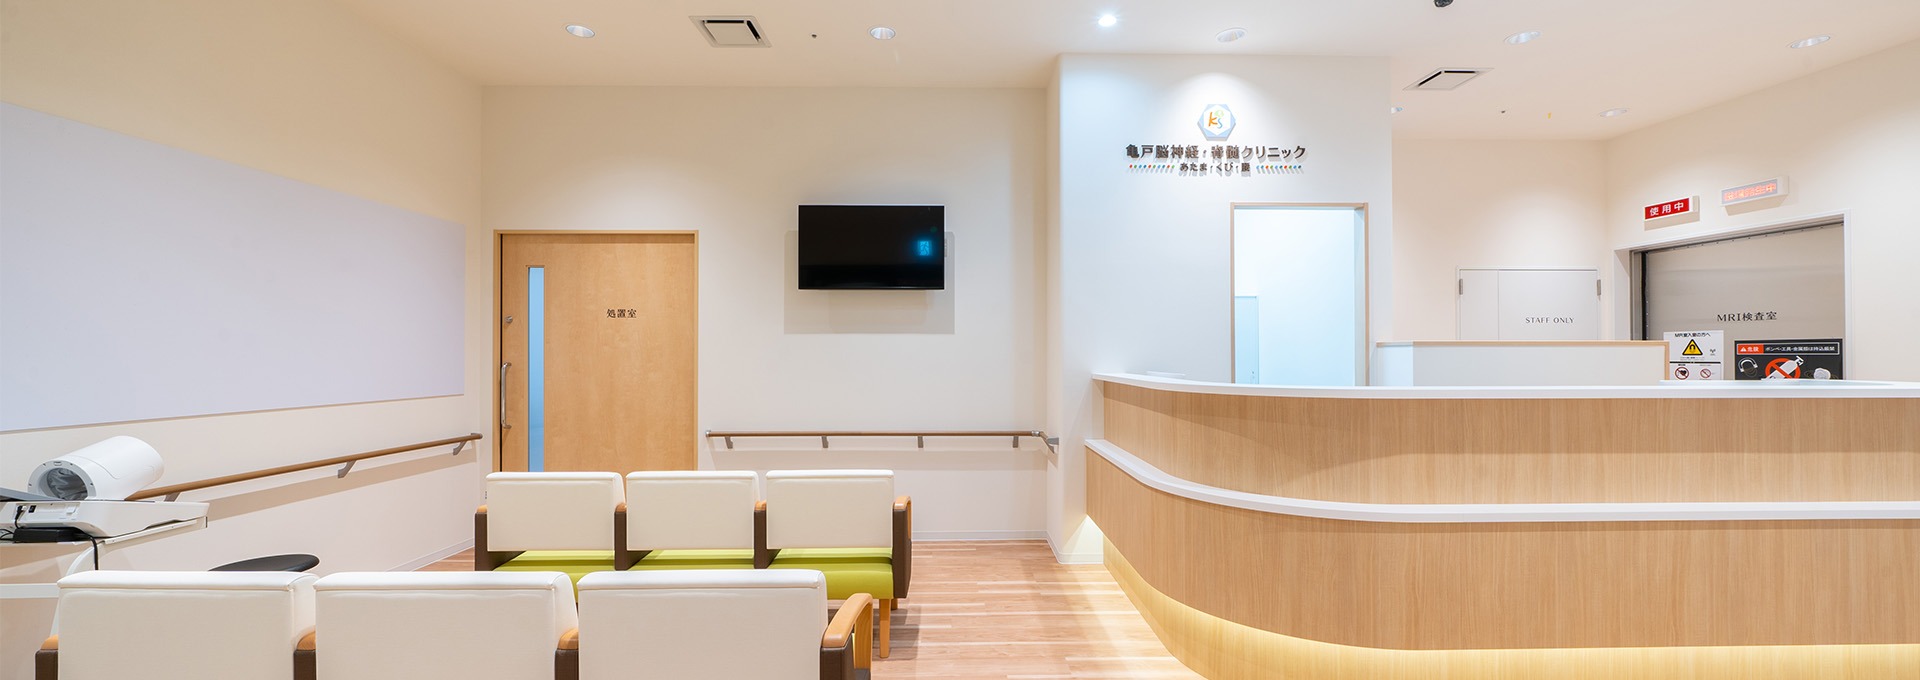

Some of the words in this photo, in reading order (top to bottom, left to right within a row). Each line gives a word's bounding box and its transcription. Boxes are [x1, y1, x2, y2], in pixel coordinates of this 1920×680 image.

[1649, 201, 1684, 217] 使用中
[606, 308, 637, 319] 処置室
[1717, 310, 1777, 322] MRI検査室
[1525, 316, 1550, 324] STAFF
[1553, 316, 1575, 324] ONLY
